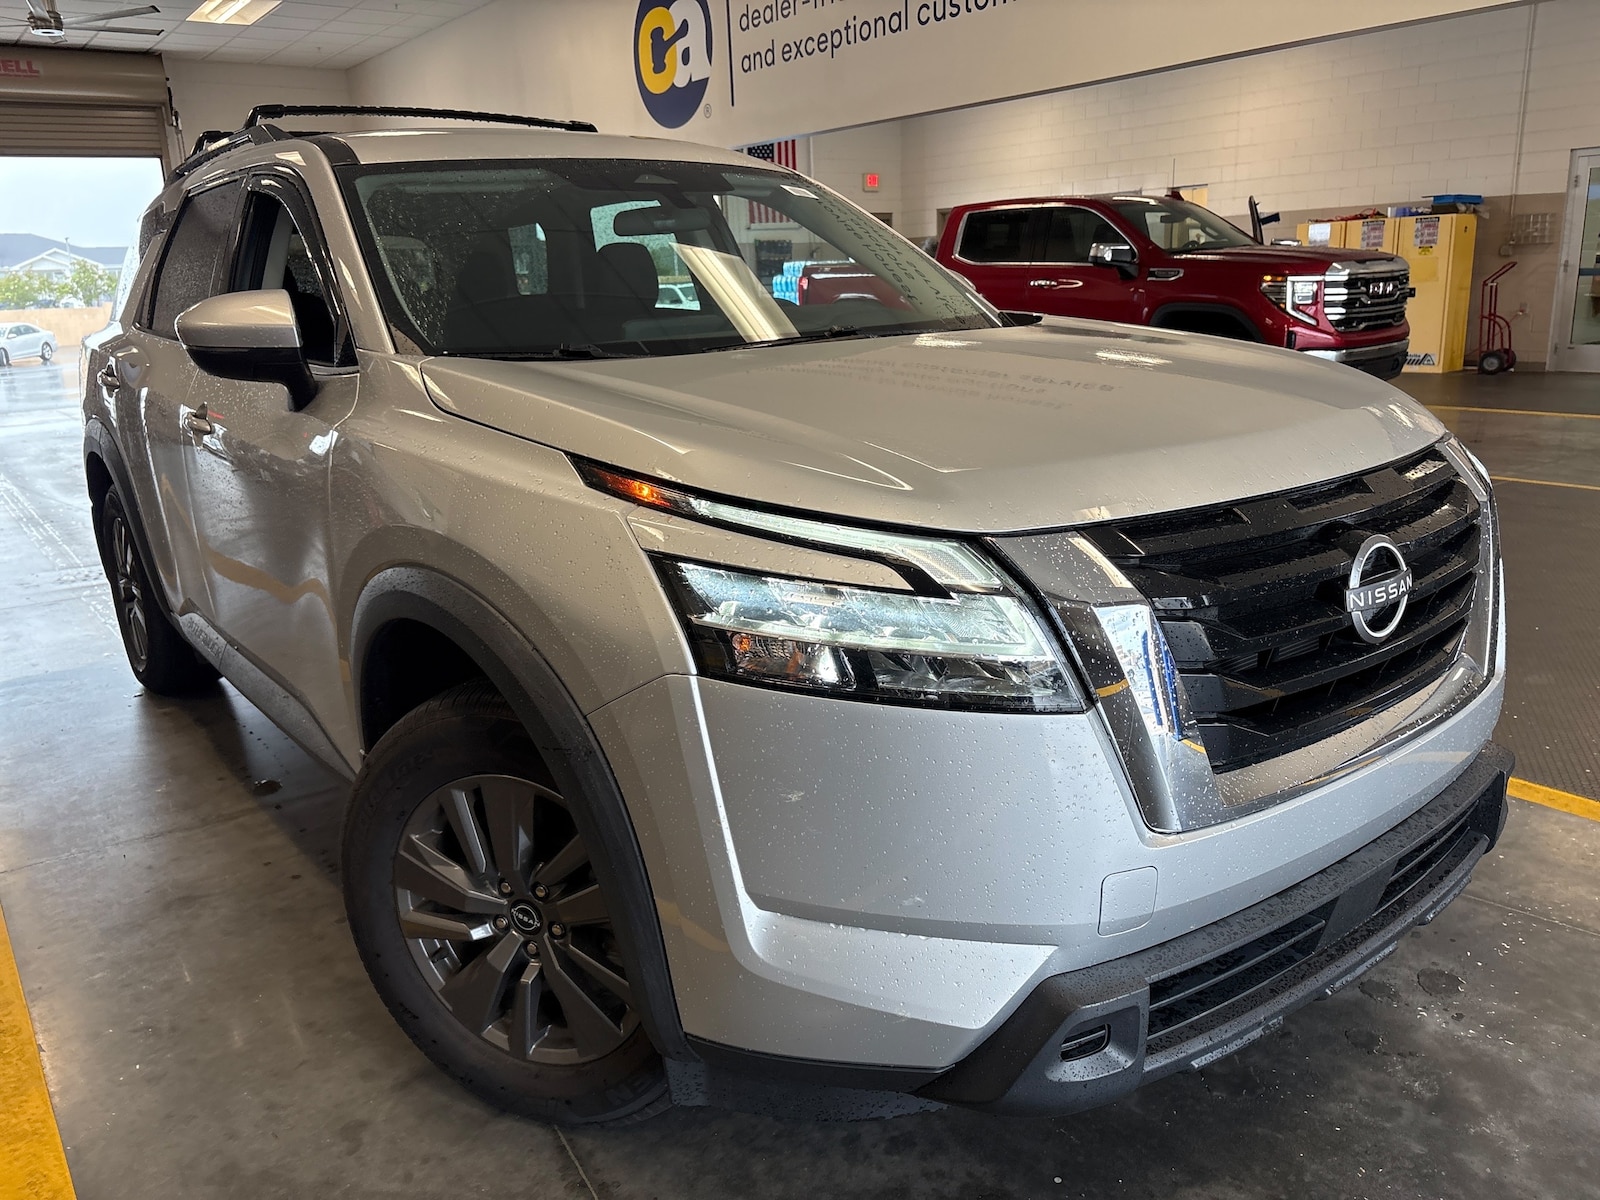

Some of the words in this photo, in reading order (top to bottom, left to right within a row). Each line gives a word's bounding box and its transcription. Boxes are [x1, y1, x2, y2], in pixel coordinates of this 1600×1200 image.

[741, 39, 775, 73] and
[781, 0, 908, 62] exceptional
[0, 59, 40, 74] ELL
[1350, 573, 1413, 609] NISSAN
[511, 908, 541, 927] NISSAN
